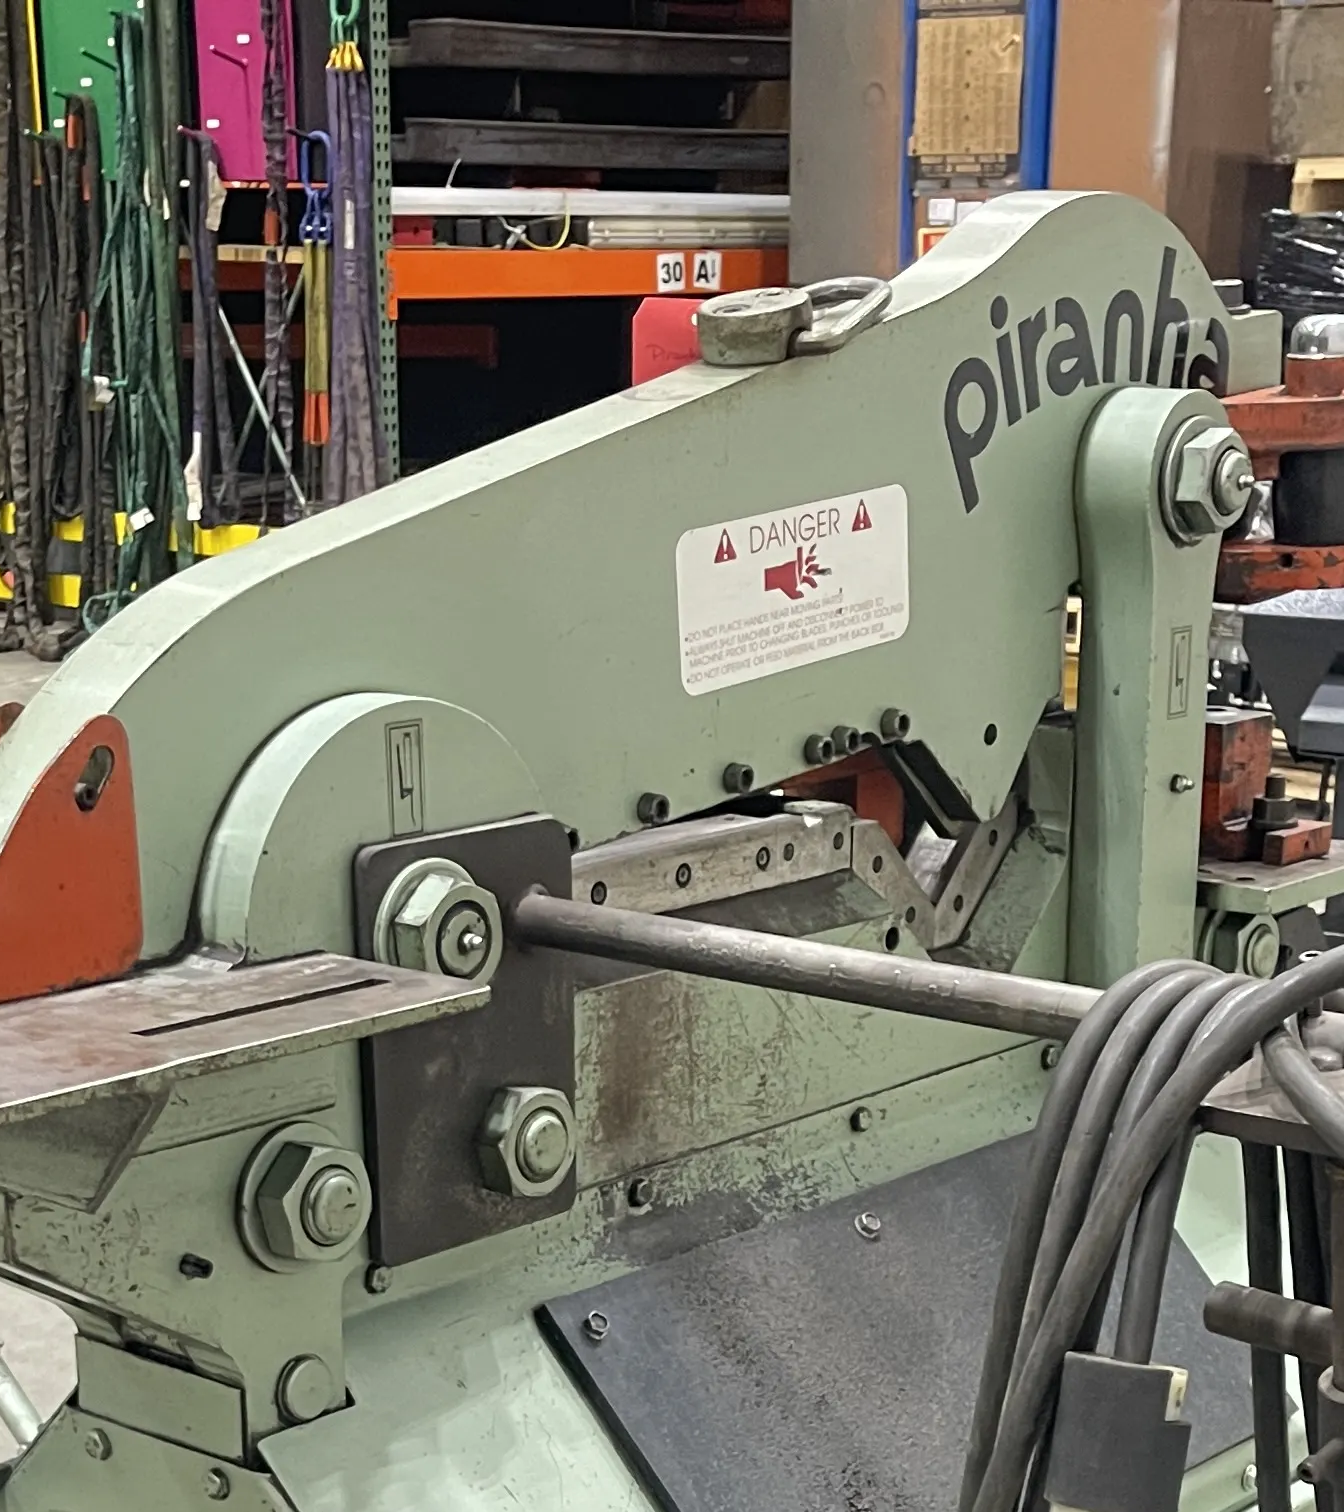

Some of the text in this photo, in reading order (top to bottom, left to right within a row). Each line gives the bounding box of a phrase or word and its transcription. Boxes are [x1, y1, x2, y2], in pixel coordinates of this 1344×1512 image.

[660, 261, 682, 284] 30
[944, 245, 1229, 514] piranha
[749, 508, 840, 554] DANGER
